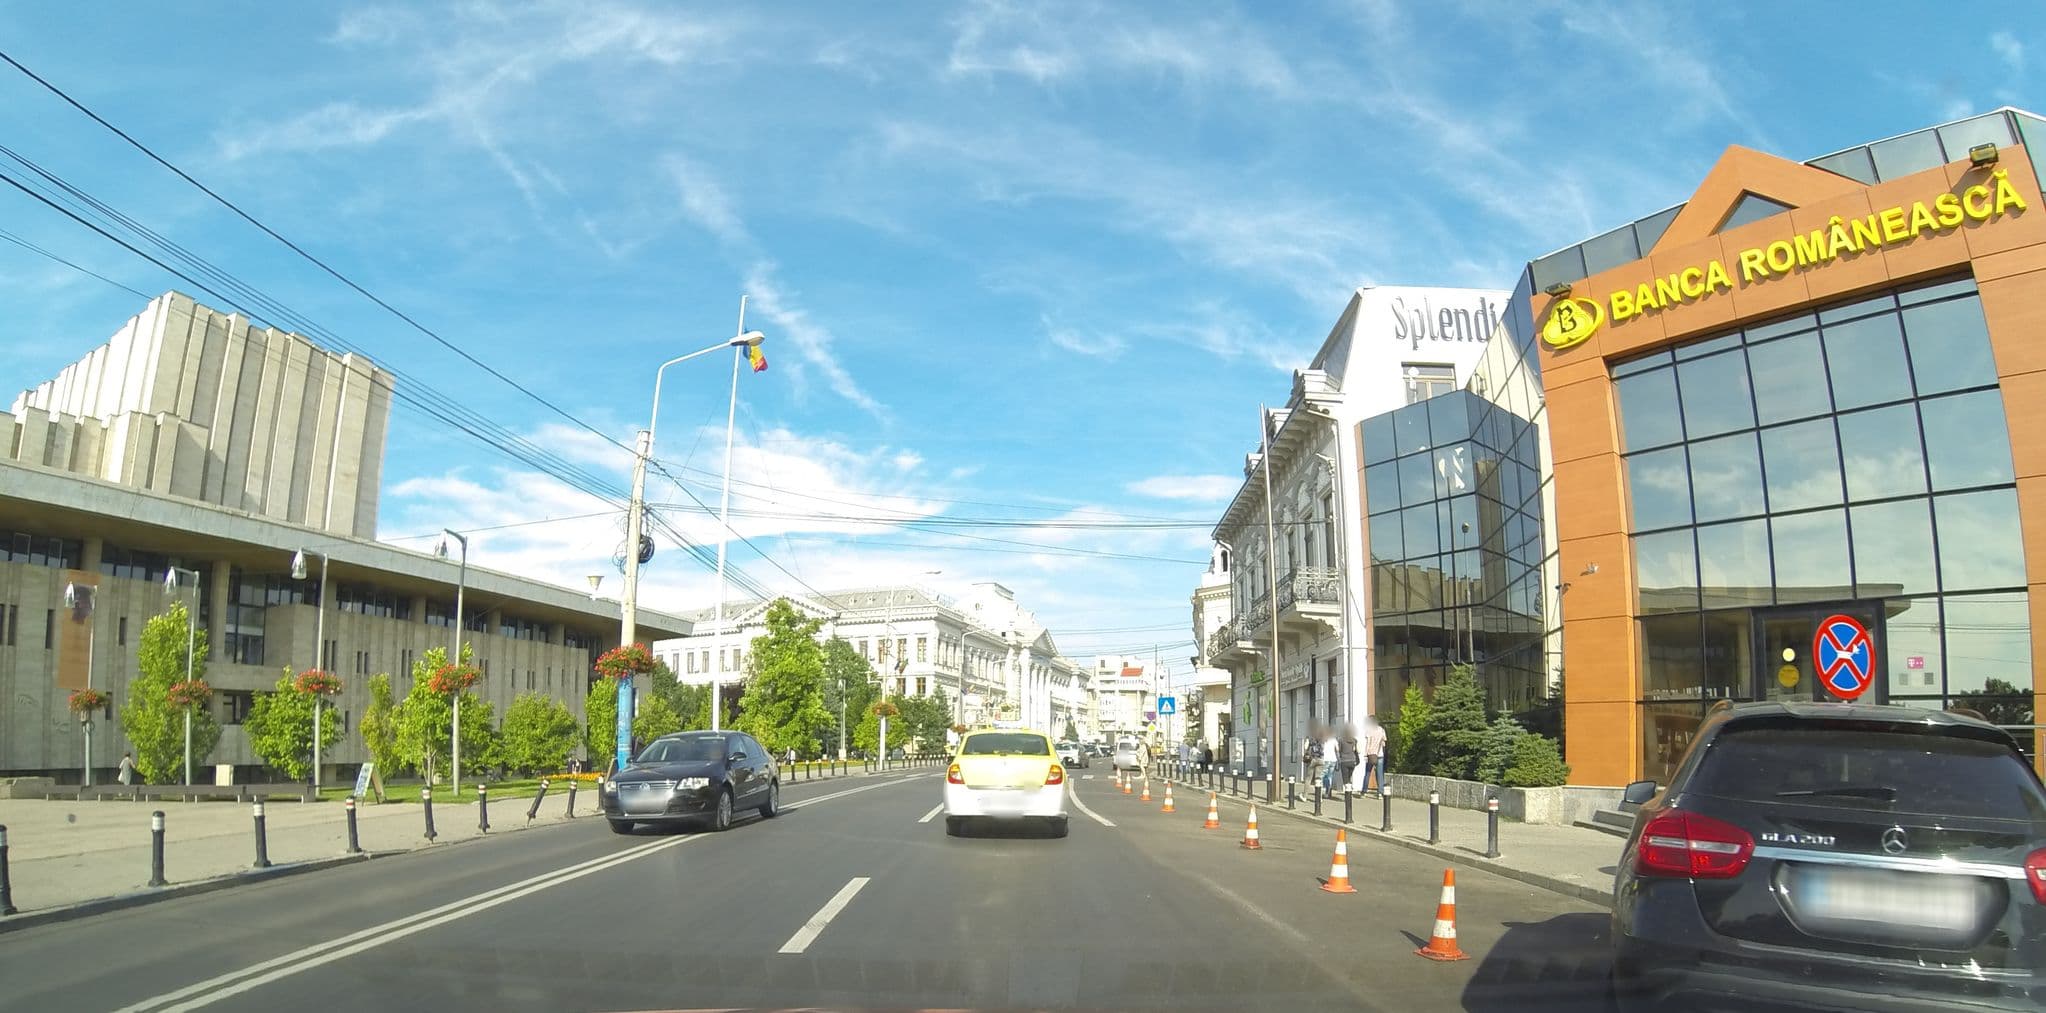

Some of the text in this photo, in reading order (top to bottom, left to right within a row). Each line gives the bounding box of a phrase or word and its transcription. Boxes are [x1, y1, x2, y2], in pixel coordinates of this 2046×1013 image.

[1609, 170, 2028, 321] BANCA ROMÂNEASCĂ
[1391, 294, 1512, 351] Splendi
[1761, 832, 1836, 846] GLA 200
